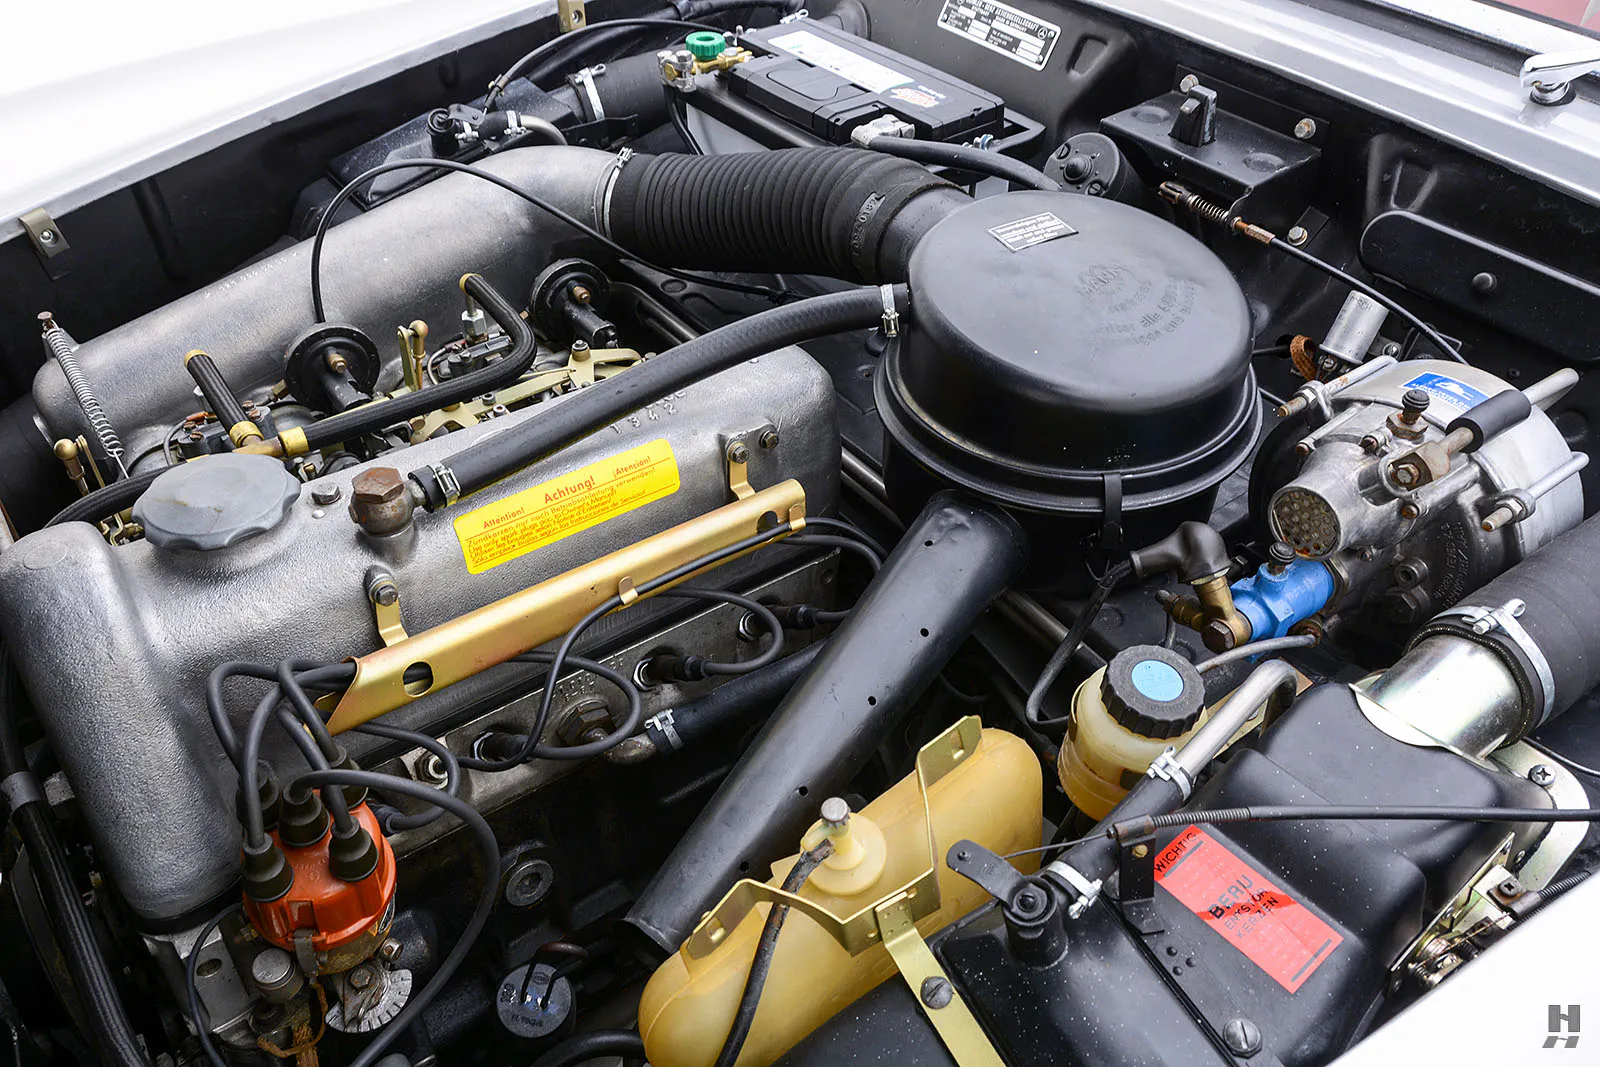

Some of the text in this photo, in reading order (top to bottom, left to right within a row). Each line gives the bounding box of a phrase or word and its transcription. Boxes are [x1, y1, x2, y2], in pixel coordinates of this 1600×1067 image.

[544, 475, 596, 504] Achtung!
[483, 507, 524, 528] Attention!
[1154, 832, 1198, 874] WICHTIG
[1208, 874, 1253, 919] BERU
